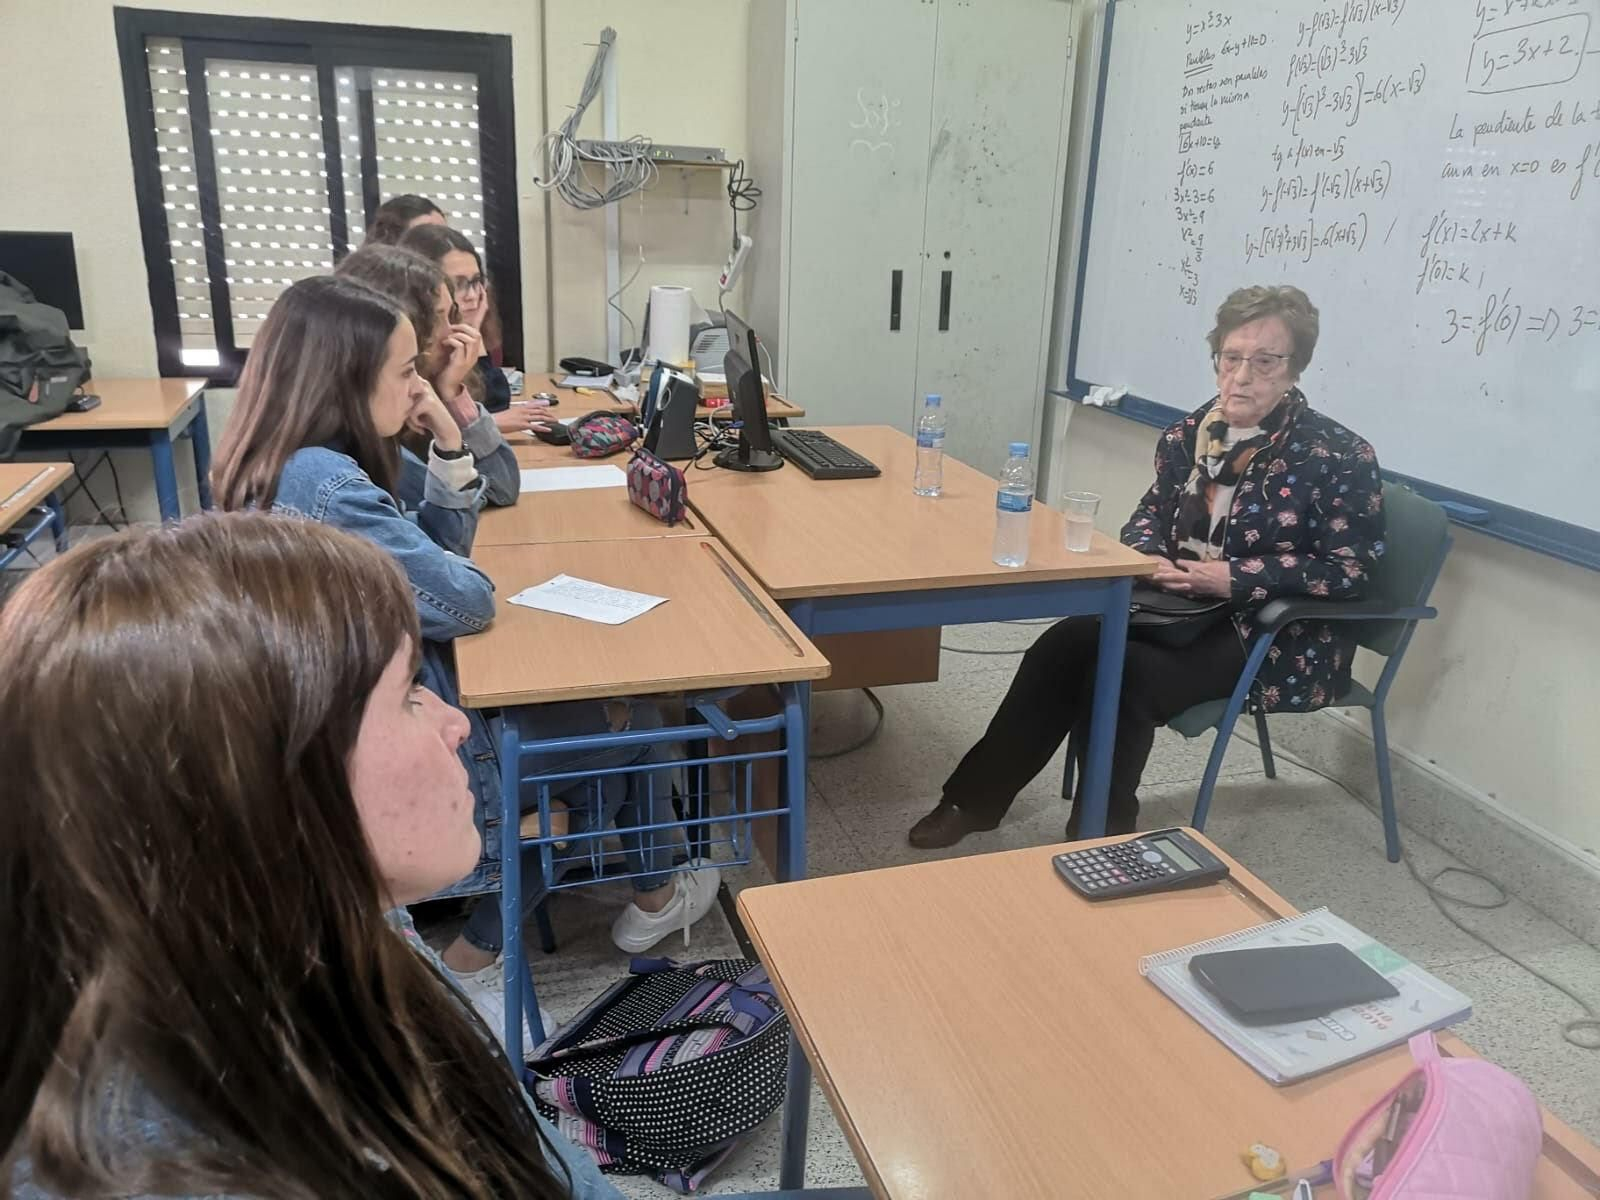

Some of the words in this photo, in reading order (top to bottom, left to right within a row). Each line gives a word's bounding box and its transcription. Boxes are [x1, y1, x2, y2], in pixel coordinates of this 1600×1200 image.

[1449, 113, 1464, 139] La
[1473, 106, 1536, 147] pendiente
[1545, 100, 1563, 128] de
[1571, 101, 1586, 126] la
[1481, 162, 1500, 178] en
[1550, 158, 1567, 174] es
